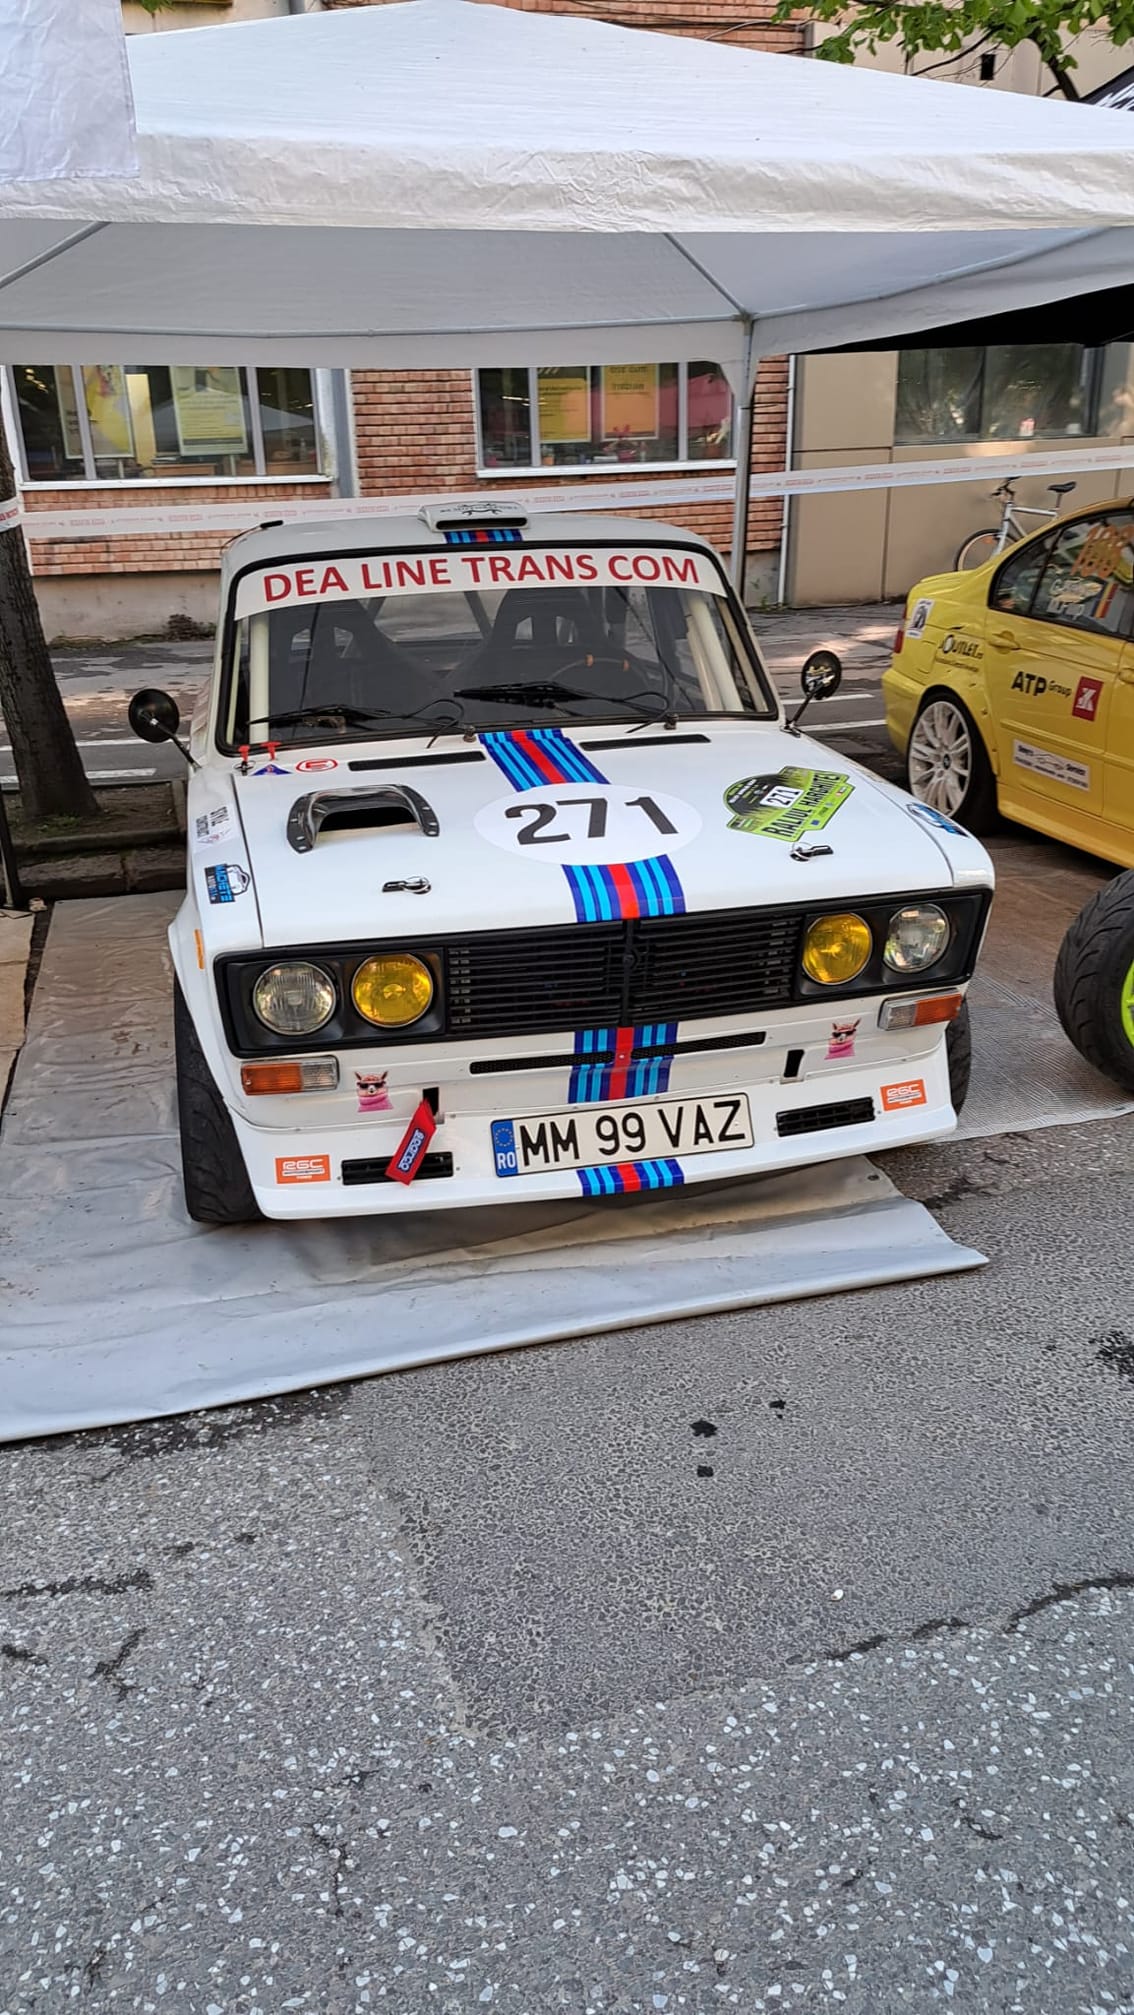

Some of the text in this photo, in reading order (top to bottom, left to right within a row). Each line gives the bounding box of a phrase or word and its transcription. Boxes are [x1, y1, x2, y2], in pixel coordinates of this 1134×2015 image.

[264, 554, 700, 602] DEA LINE TRANS COM
[1011, 671, 1047, 697] ATP
[767, 789, 801, 807] 271
[504, 796, 679, 846] 271
[761, 807, 813, 838] RALIUL
[519, 1099, 746, 1167] MM 99 VAZ
[282, 1159, 324, 1170] RGC
[497, 1151, 516, 1170] RO
